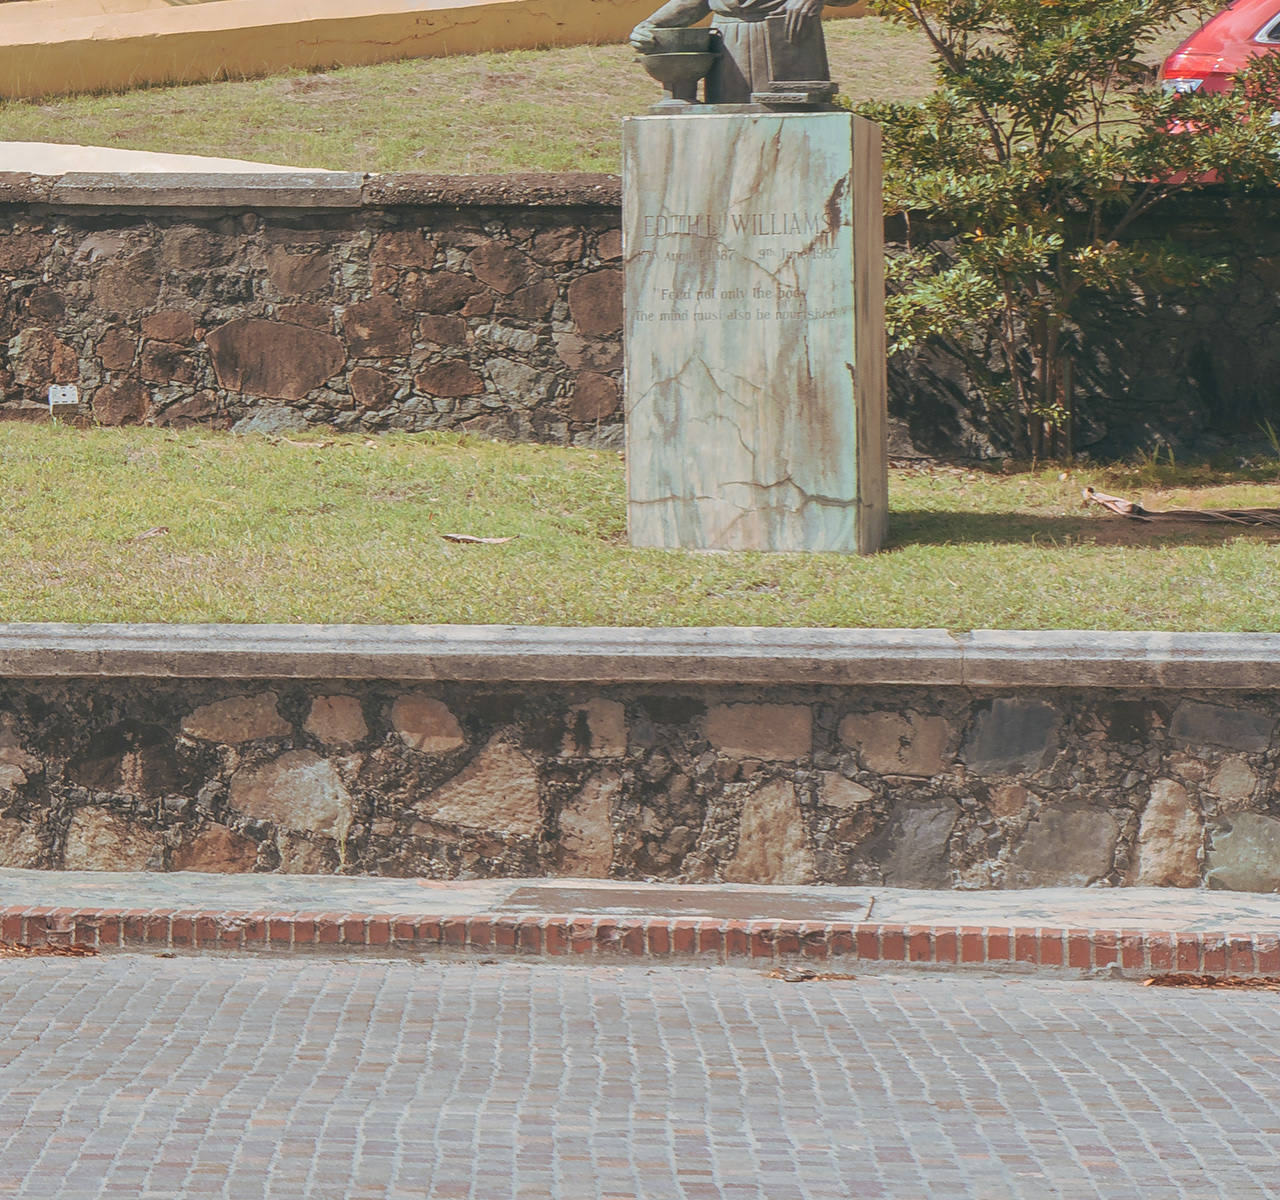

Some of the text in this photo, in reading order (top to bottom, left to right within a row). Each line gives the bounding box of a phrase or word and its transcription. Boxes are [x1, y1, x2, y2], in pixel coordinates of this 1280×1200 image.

[643, 215, 700, 237] EDITH
[731, 212, 832, 236] WILLIAMS
[778, 248, 807, 261] June
[812, 247, 839, 260] 1987
[696, 287, 715, 300] not
[720, 288, 748, 302] only
[752, 286, 772, 300] the
[635, 310, 654, 321] The
[659, 309, 688, 321] mind
[693, 310, 722, 321] must
[727, 309, 752, 321] also
[756, 308, 771, 321] be
